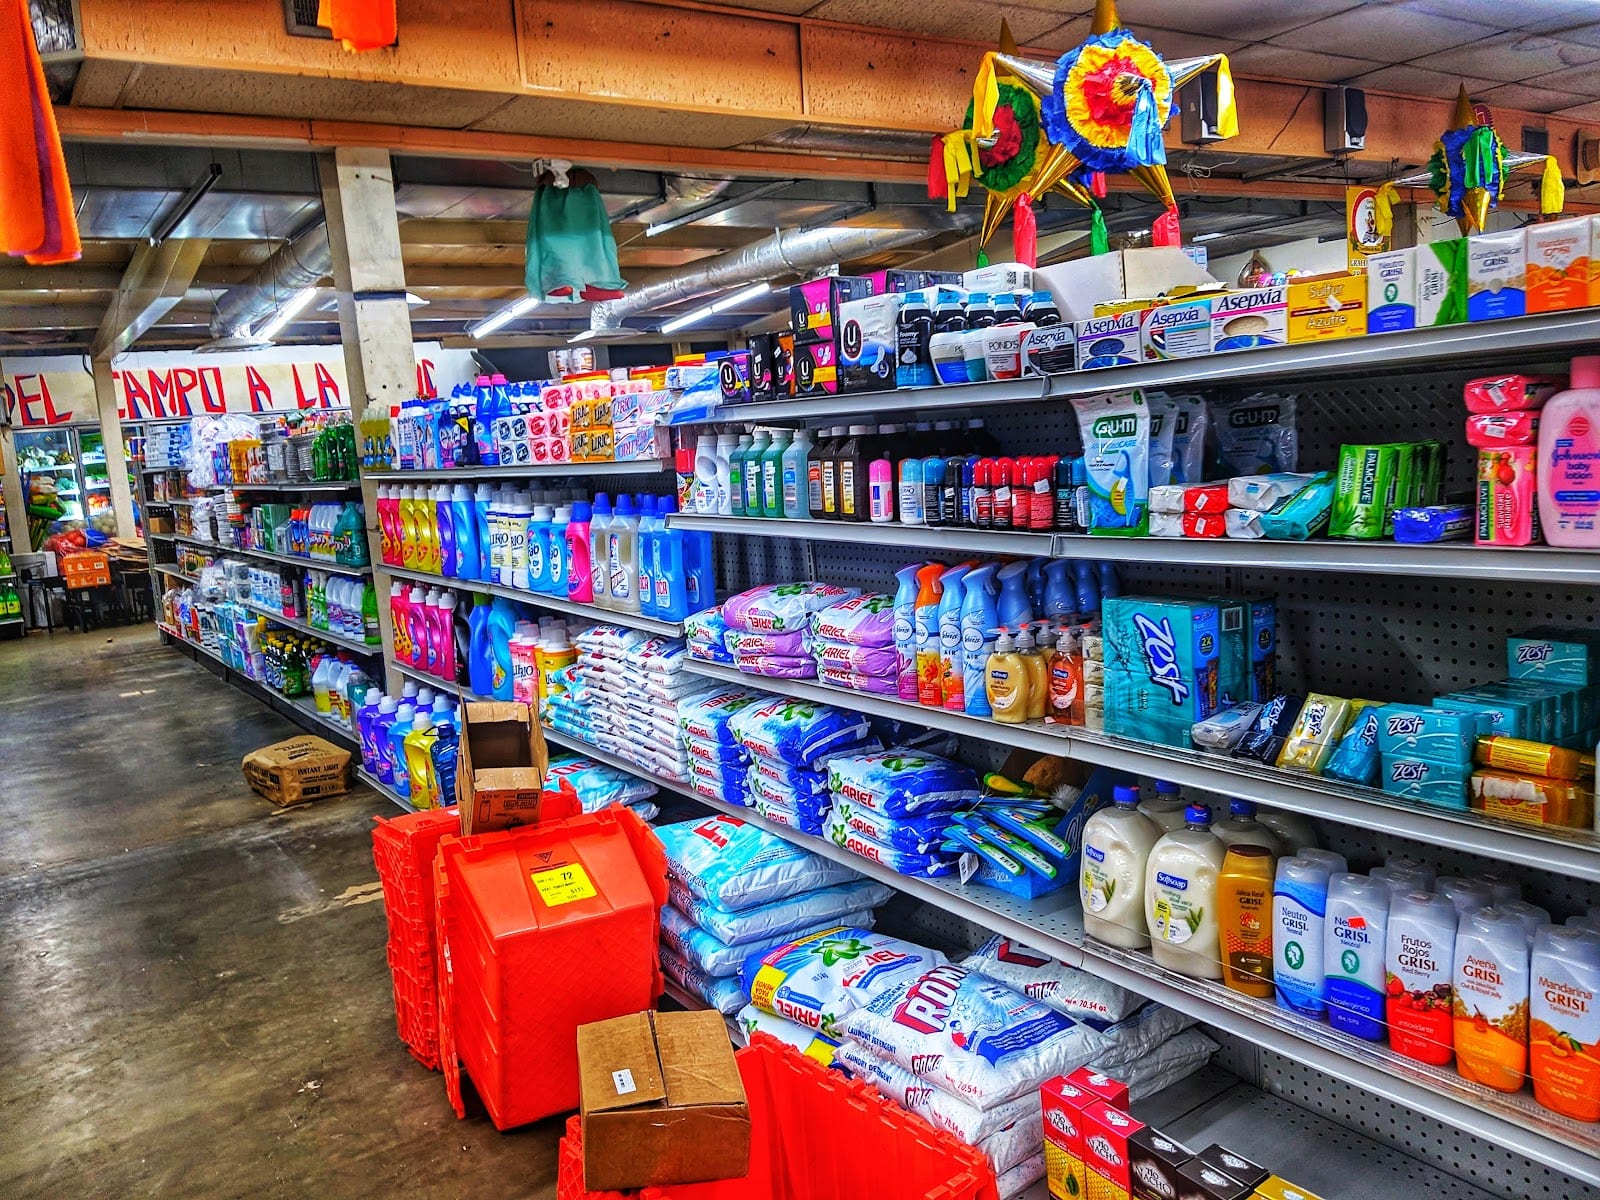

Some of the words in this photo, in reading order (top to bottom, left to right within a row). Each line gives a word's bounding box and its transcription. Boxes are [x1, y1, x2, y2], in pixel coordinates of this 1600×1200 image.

[1309, 283, 1344, 298] Sulfur
[1216, 289, 1283, 313] Asepxia
[1082, 314, 1135, 336] Asepxia
[1151, 307, 1200, 327] Asepxia
[1307, 314, 1347, 329] Azufre
[846, 325, 857, 346] U
[1027, 329, 1066, 347] Asepxia
[988, 339, 1020, 350] POND'S
[723, 368, 733, 384] U
[246, 366, 273, 412] A
[292, 362, 342, 409] LA
[1567, 462, 1591, 472] baby
[1361, 453, 1377, 504] PALMOLIVE
[1564, 472, 1594, 480] lotion
[1480, 484, 1489, 538] PALMOLIVE
[819, 624, 847, 638] ARIEL
[823, 648, 851, 661] ARIEL
[840, 784, 877, 809] ARIEL
[845, 838, 885, 865] ARIEL
[560, 872, 574, 882] 72
[1158, 873, 1187, 889] Softsoap
[1281, 906, 1308, 922] Neutro
[1340, 938, 1361, 949] Neutral
[1400, 934, 1432, 949] Frutos
[1402, 943, 1430, 959] Rojos
[1466, 955, 1498, 971] Avena
[1401, 966, 1414, 975] Red
[1414, 967, 1431, 979] Berry
[1538, 975, 1594, 1000] Mandarina
[1078, 1000, 1098, 1010] 70.54
[775, 998, 822, 1030] ARIEL
[957, 1080, 977, 1096] 70.54
